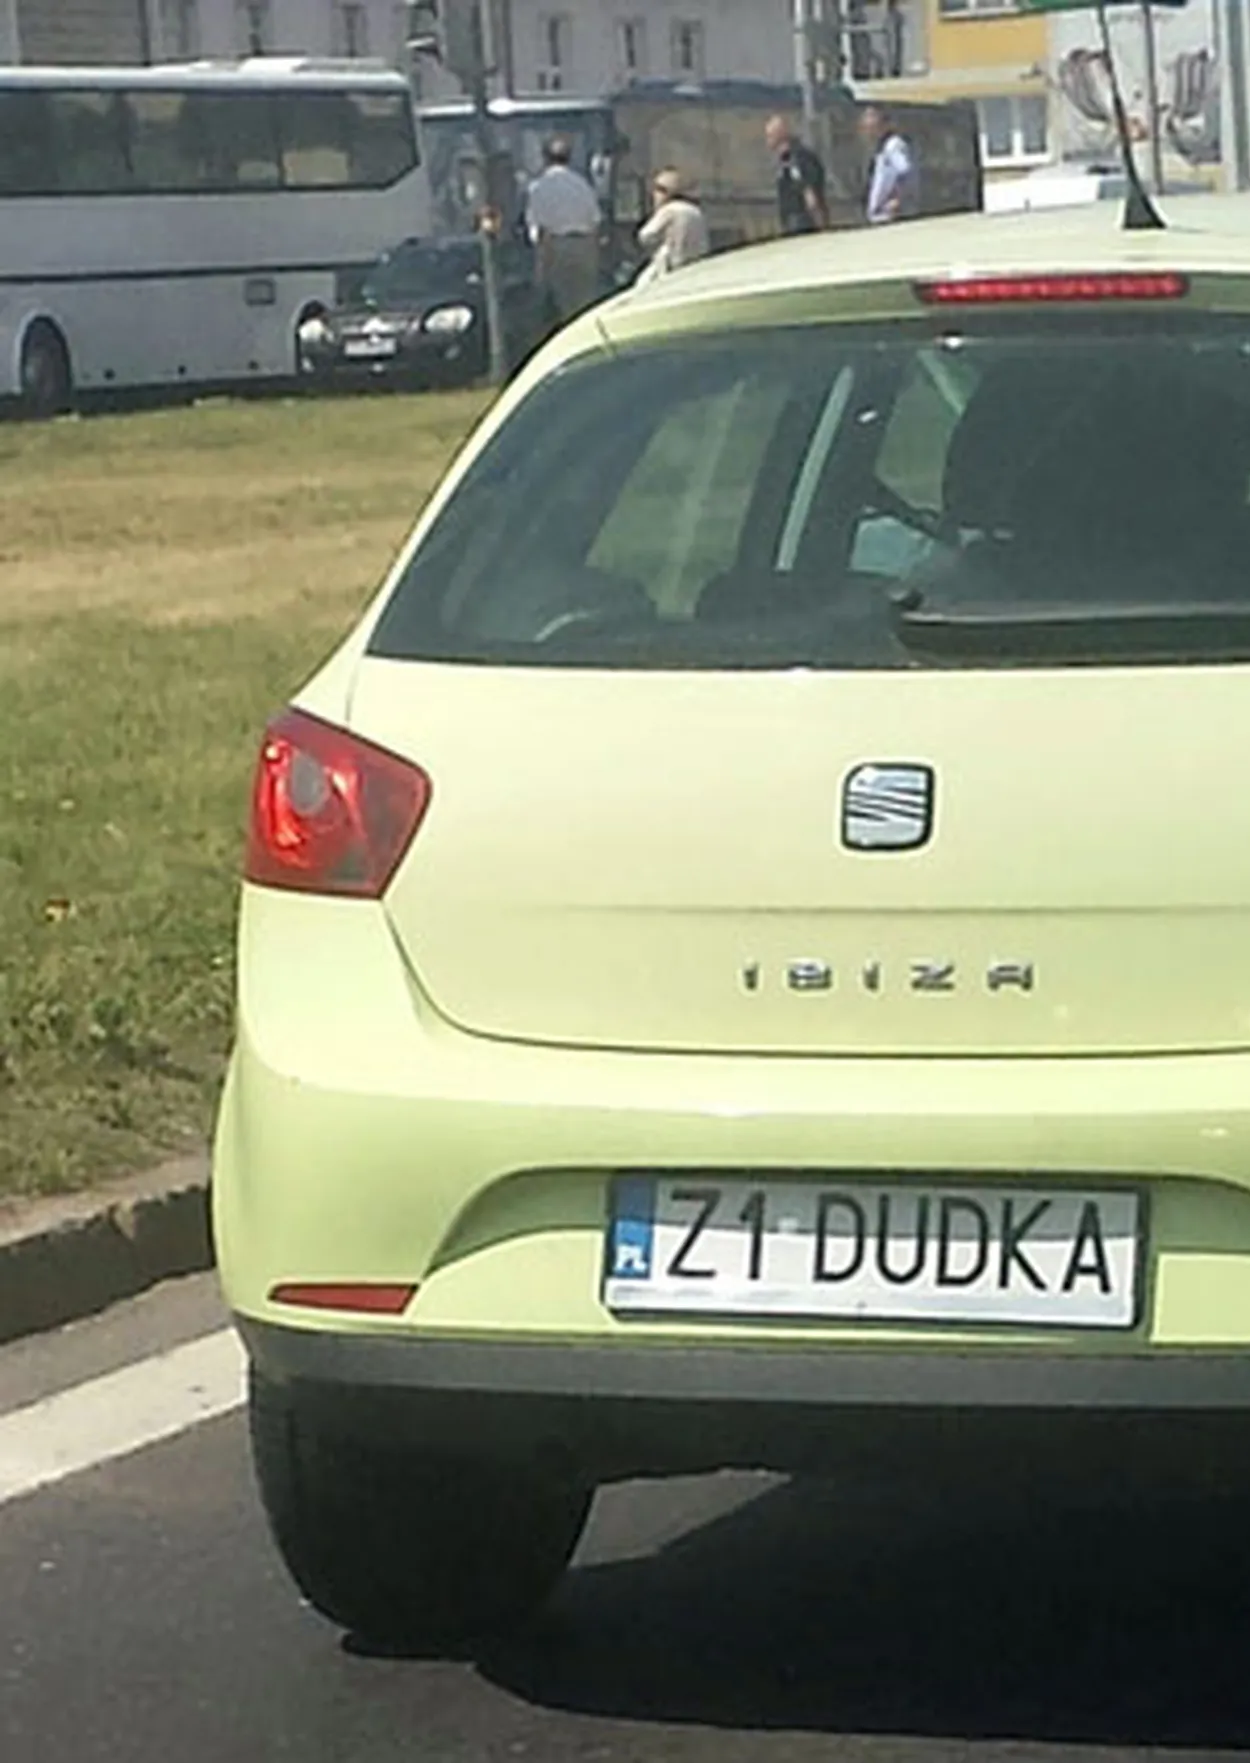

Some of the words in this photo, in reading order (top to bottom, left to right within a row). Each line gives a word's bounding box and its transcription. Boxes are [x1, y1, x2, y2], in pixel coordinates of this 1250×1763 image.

[741, 960, 1035, 992] IBIZA
[665, 1187, 768, 1281] Z1
[811, 1190, 1113, 1295] DUDKA
